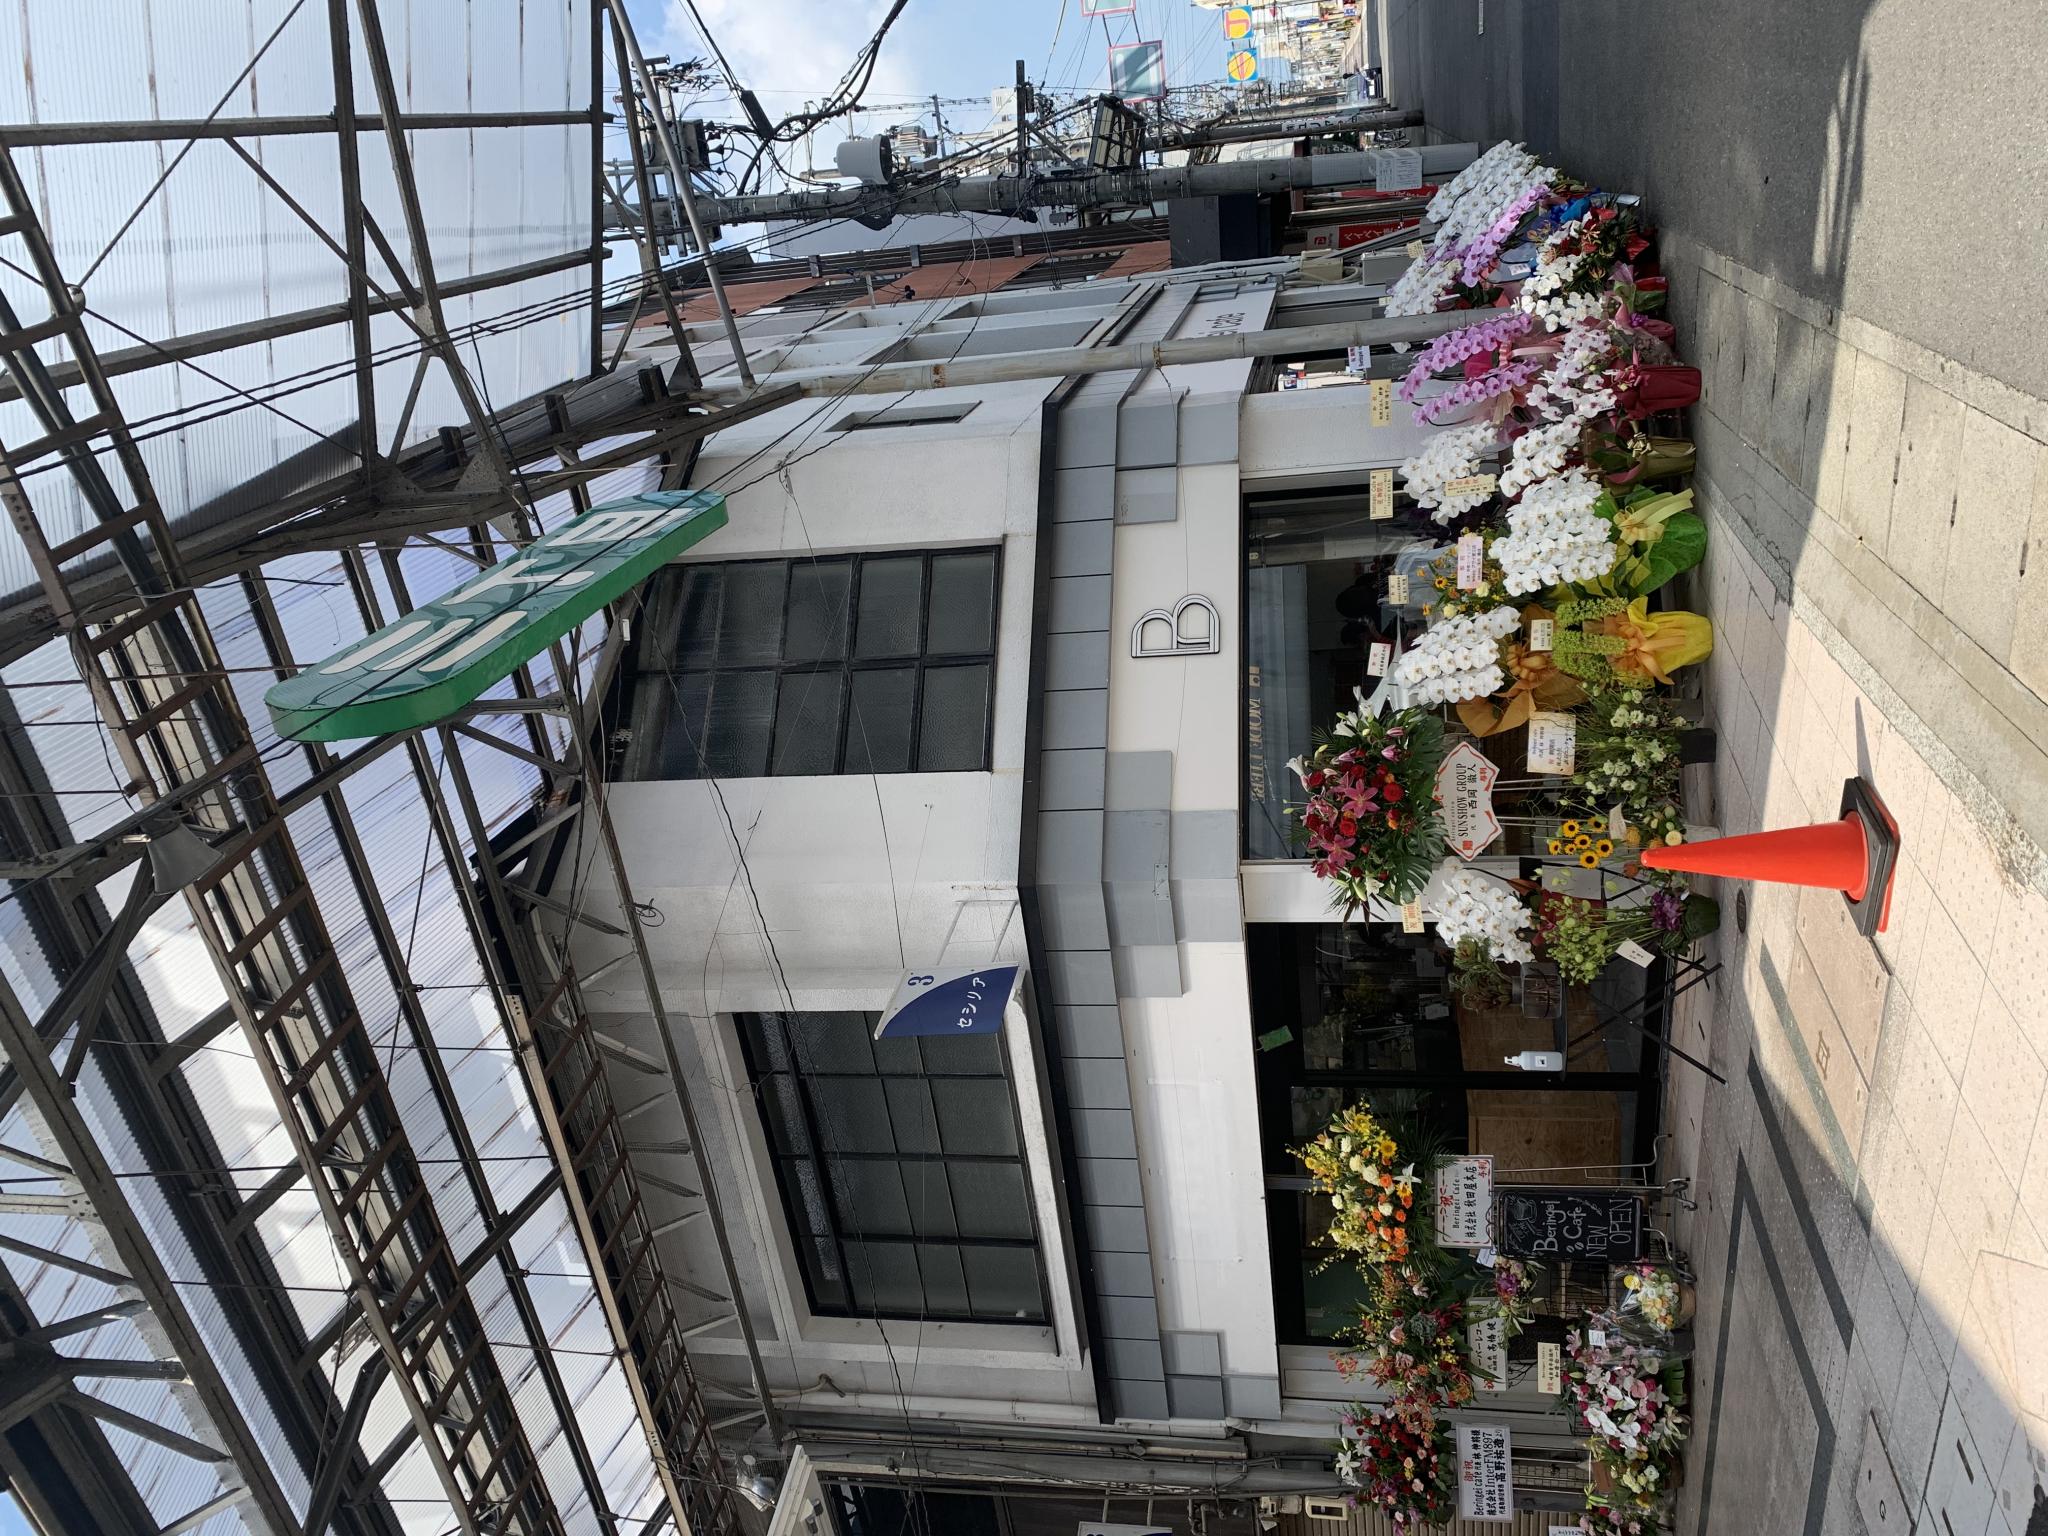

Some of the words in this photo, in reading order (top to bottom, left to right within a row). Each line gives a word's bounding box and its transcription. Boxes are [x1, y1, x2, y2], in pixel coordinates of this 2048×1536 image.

[1130, 594, 1220, 658] B
[1455, 763, 1467, 792] GROUP
[1468, 789, 1478, 810] 西岡
[1457, 795, 1469, 837] SUNSHOW
[907, 975, 934, 986] 3
[956, 977, 986, 1028] セシリア
[1452, 1179, 1460, 1195] Cafe
[1463, 1165, 1477, 1207] 秋田屋本店
[1440, 1195, 1454, 1207] 祝
[1453, 1199, 1461, 1228] Beringei
[1464, 1211, 1477, 1238] 株式会社
[1532, 1200, 1567, 1252] Beringei
[1562, 1206, 1587, 1239] Cafe
[1608, 1198, 1633, 1244] OPEN
[1586, 1224, 1608, 1258] NEW
[1463, 1459, 1474, 1482] 御祝
[1474, 1471, 1483, 1487] cafe
[1472, 1487, 1485, 1516] Beringei
